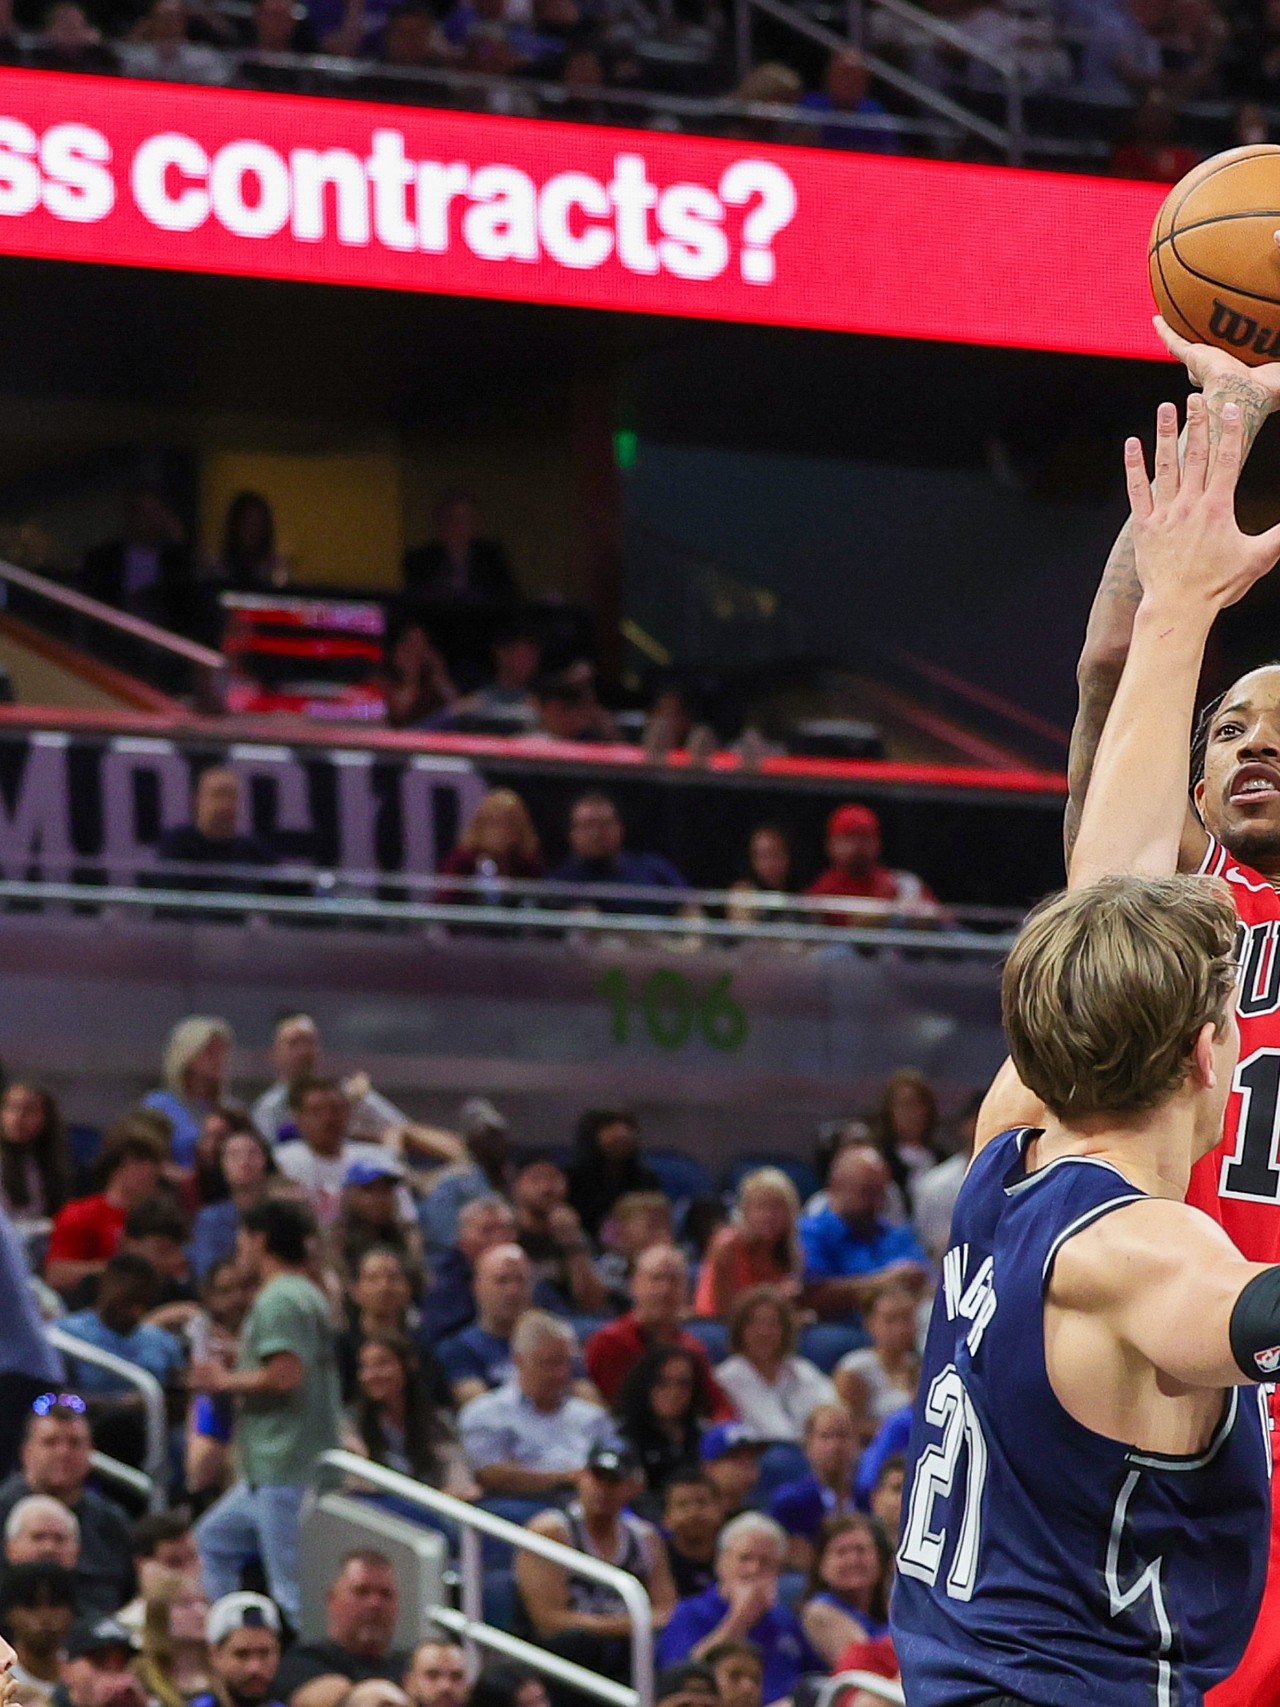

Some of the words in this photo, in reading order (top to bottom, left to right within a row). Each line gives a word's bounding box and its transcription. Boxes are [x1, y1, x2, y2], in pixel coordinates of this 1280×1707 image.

[131, 129, 798, 284] contracts?
[596, 966, 748, 1053] 106
[897, 1362, 988, 1602] 21
